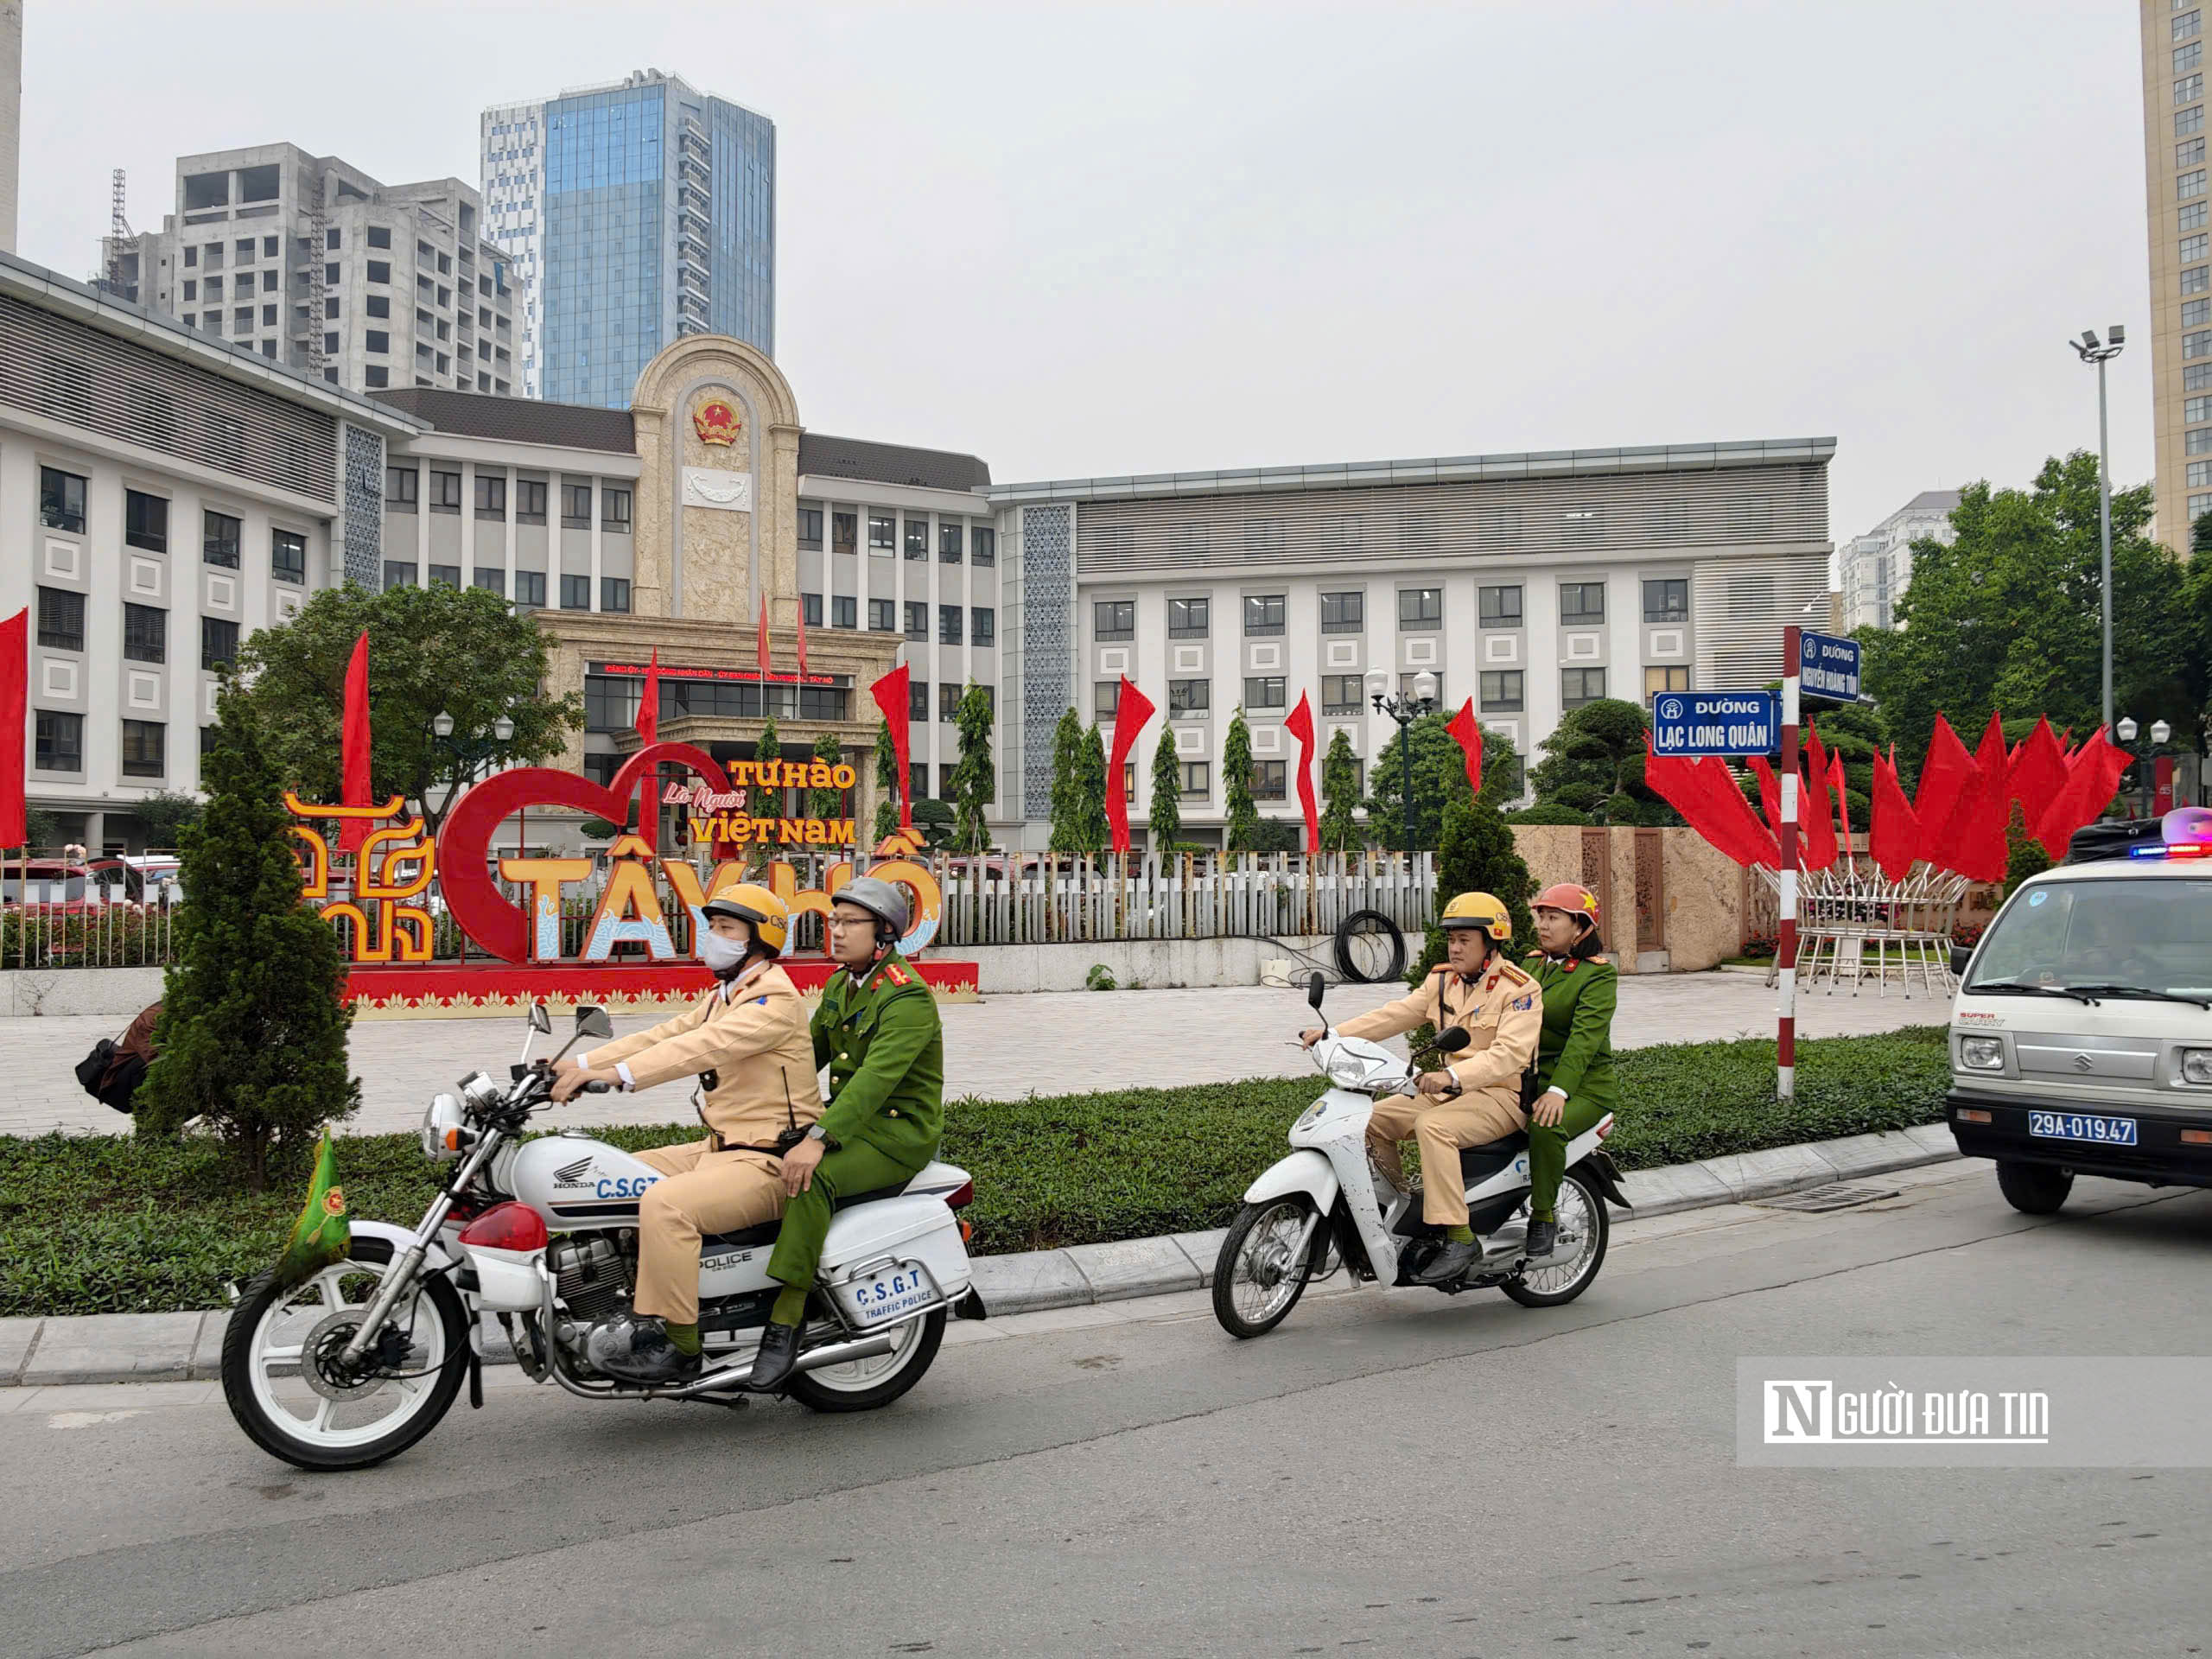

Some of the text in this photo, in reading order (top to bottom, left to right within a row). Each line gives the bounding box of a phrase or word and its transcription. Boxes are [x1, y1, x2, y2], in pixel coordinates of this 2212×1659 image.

[1822, 645, 1854, 662] ĐƯỜNG
[1695, 698, 1760, 714] ĐƯỜNG
[1659, 721, 1767, 750] LẠC LONG QUÂN
[2031, 1114, 2133, 1141] 29A-019.47
[866, 1290, 932, 1319] TRAFFIC POLICE
